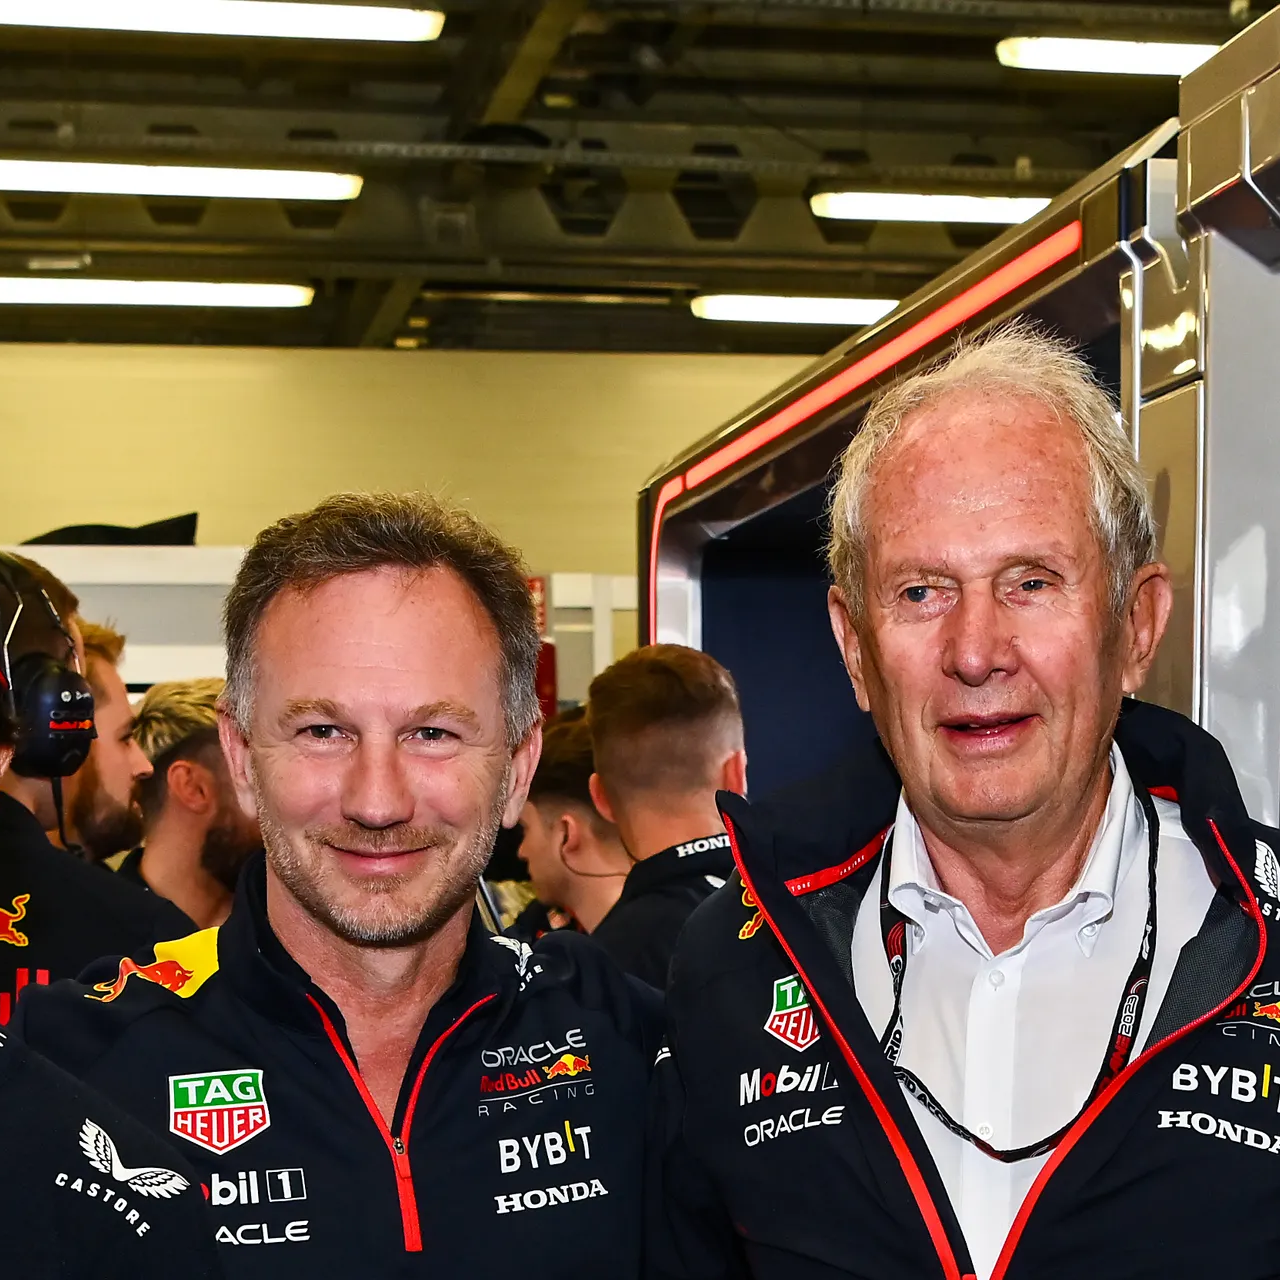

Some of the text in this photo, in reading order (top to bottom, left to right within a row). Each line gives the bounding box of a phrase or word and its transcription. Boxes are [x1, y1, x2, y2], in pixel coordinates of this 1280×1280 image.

[772, 1009, 820, 1046] HEU
[1118, 994, 1139, 1037] 2023
[482, 1029, 587, 1069] ORACLE
[178, 1076, 258, 1105] TAG
[477, 1083, 595, 1117] RACING
[480, 1068, 541, 1094] Red Bull
[740, 1063, 821, 1107] Mobil
[177, 1108, 264, 1148] HEUER
[744, 1106, 846, 1147] ORACLE
[498, 1120, 592, 1174] BYBIT
[55, 1173, 151, 1237] CASTORE
[201, 1170, 292, 1206] bil 1
[494, 1177, 608, 1215] HONDA
[216, 1220, 310, 1246] ACLE
